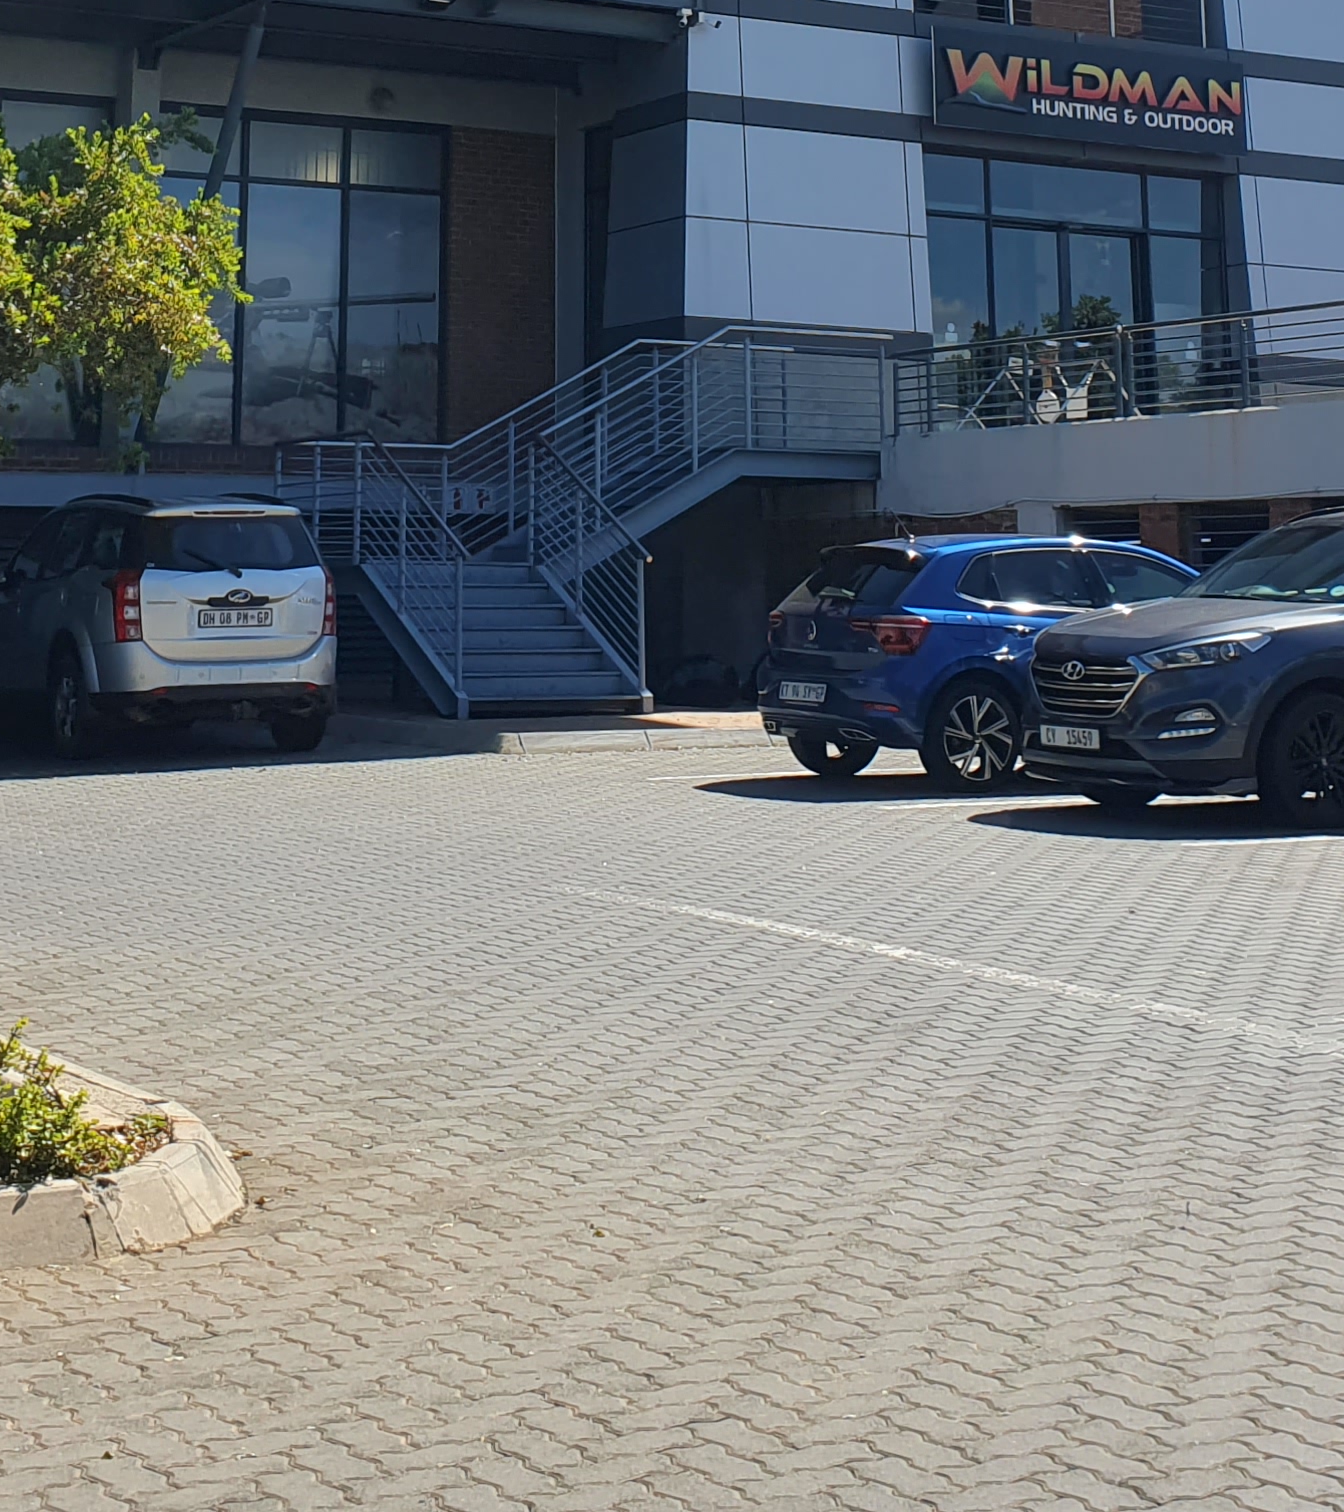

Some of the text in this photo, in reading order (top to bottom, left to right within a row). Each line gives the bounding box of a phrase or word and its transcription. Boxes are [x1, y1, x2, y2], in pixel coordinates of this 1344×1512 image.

[1032, 98, 1234, 136] HUNTING & OUTDOOR
[257, 611, 269, 625] GP
